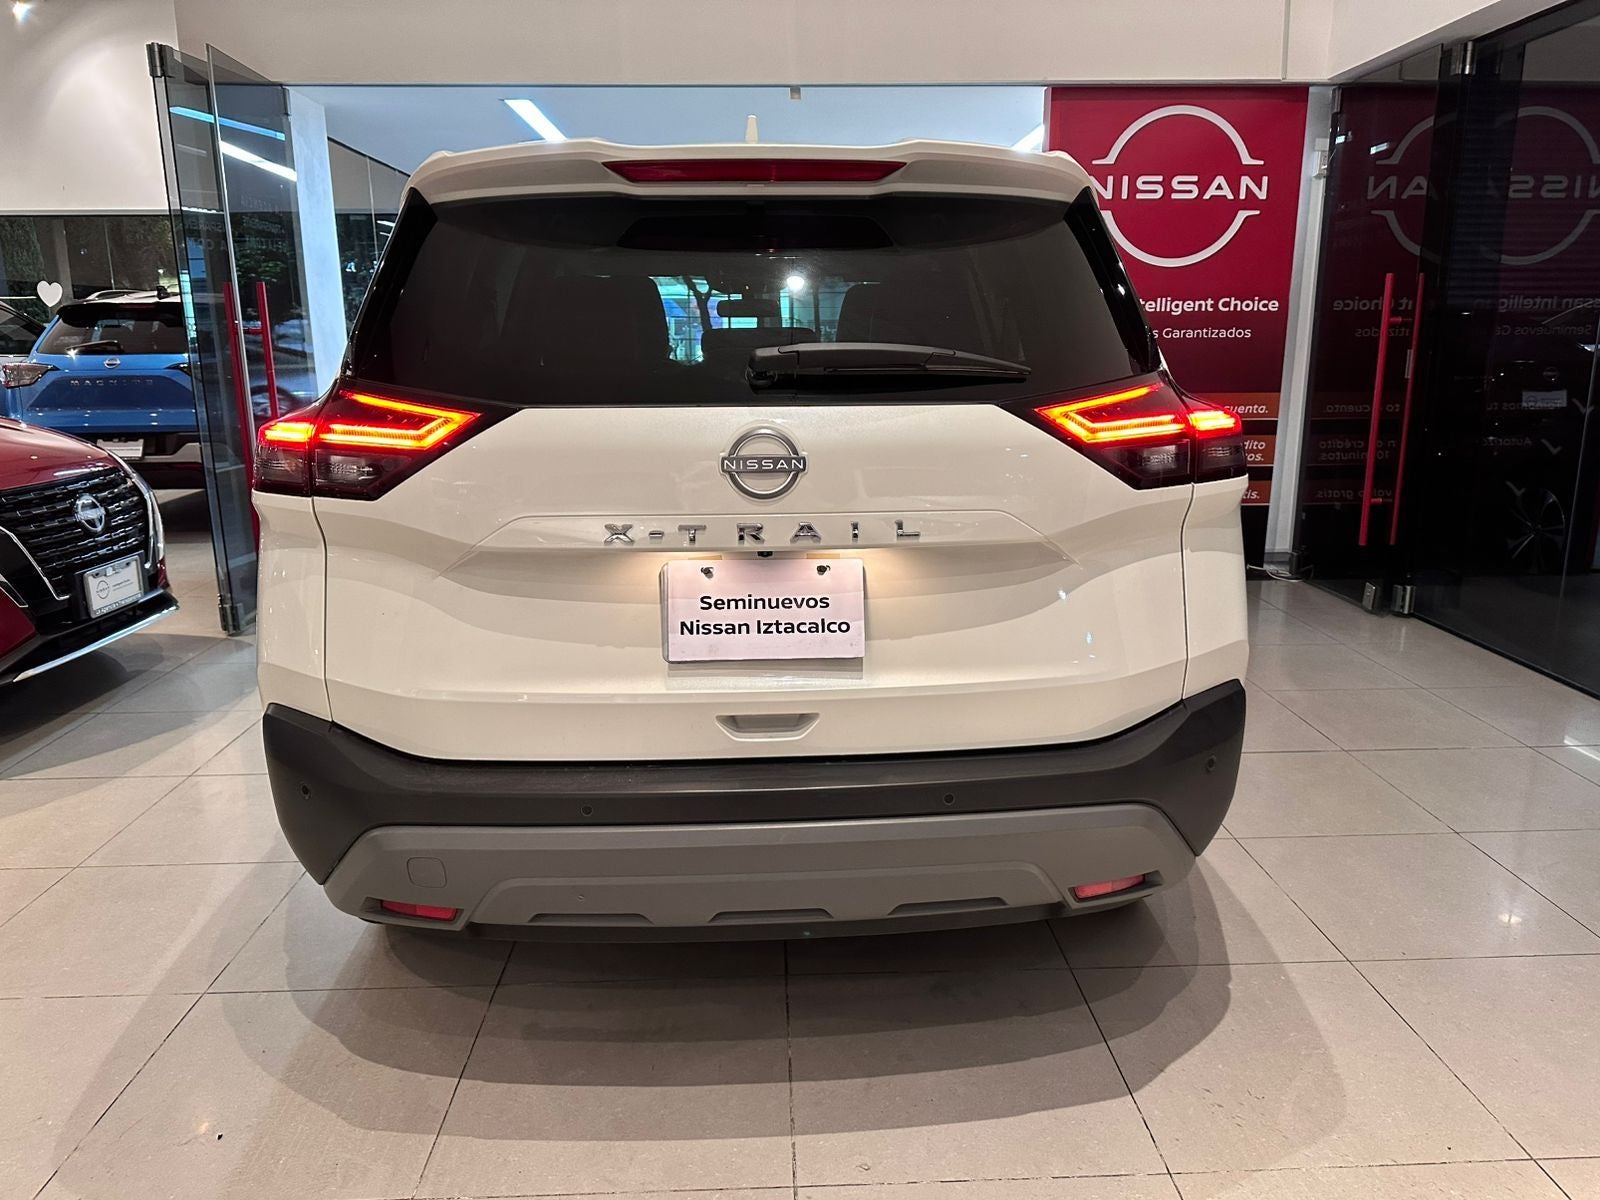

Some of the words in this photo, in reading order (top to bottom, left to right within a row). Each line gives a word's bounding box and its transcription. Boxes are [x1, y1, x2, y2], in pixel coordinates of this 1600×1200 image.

[1089, 175, 1268, 200] NISSAN
[1139, 297, 1214, 315] elligent
[1218, 297, 1279, 311] Choice
[1162, 327, 1252, 339] Garantizados
[724, 459, 804, 470] NISSAN
[604, 519, 921, 546] X-TRAIL
[700, 594, 830, 610] Seminuevos
[680, 620, 750, 635] Nissan
[756, 618, 851, 634] Iztacalco
